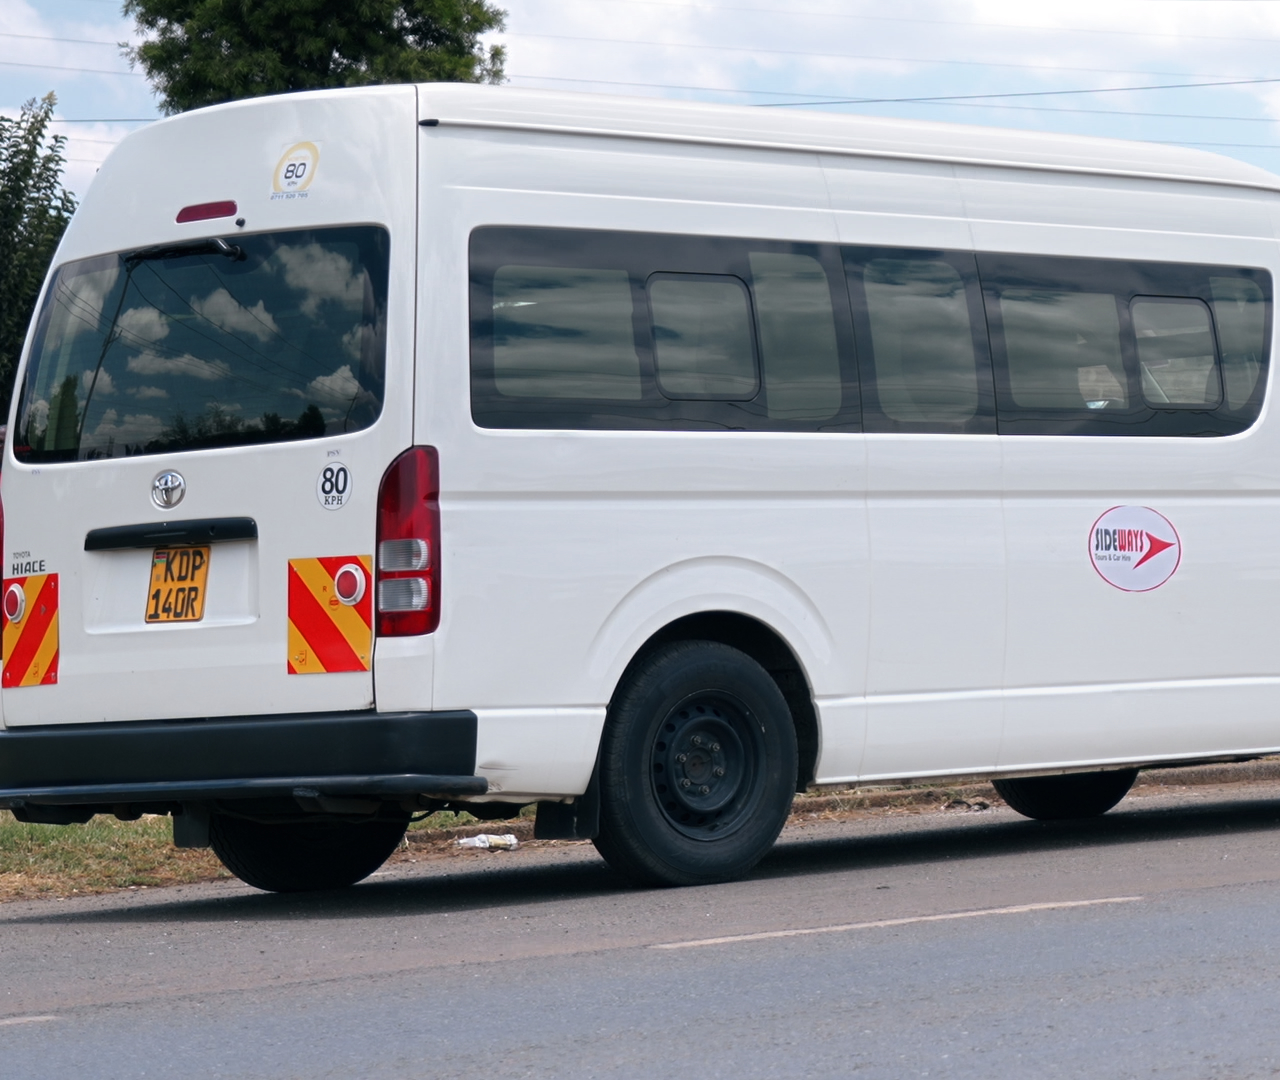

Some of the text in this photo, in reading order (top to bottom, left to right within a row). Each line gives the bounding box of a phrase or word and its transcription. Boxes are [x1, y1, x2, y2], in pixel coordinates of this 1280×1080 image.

[284, 163, 306, 179] 80
[321, 466, 348, 495] 80
[324, 495, 343, 505] KPH
[1095, 528, 1144, 552] SIDEWAYS
[13, 551, 31, 559] TOYOTA
[1094, 553, 1107, 561] Tours
[1121, 554, 1131, 562] Hire
[12, 559, 46, 576] HIACE
[164, 549, 204, 583] KDP
[147, 586, 198, 620] 140R
